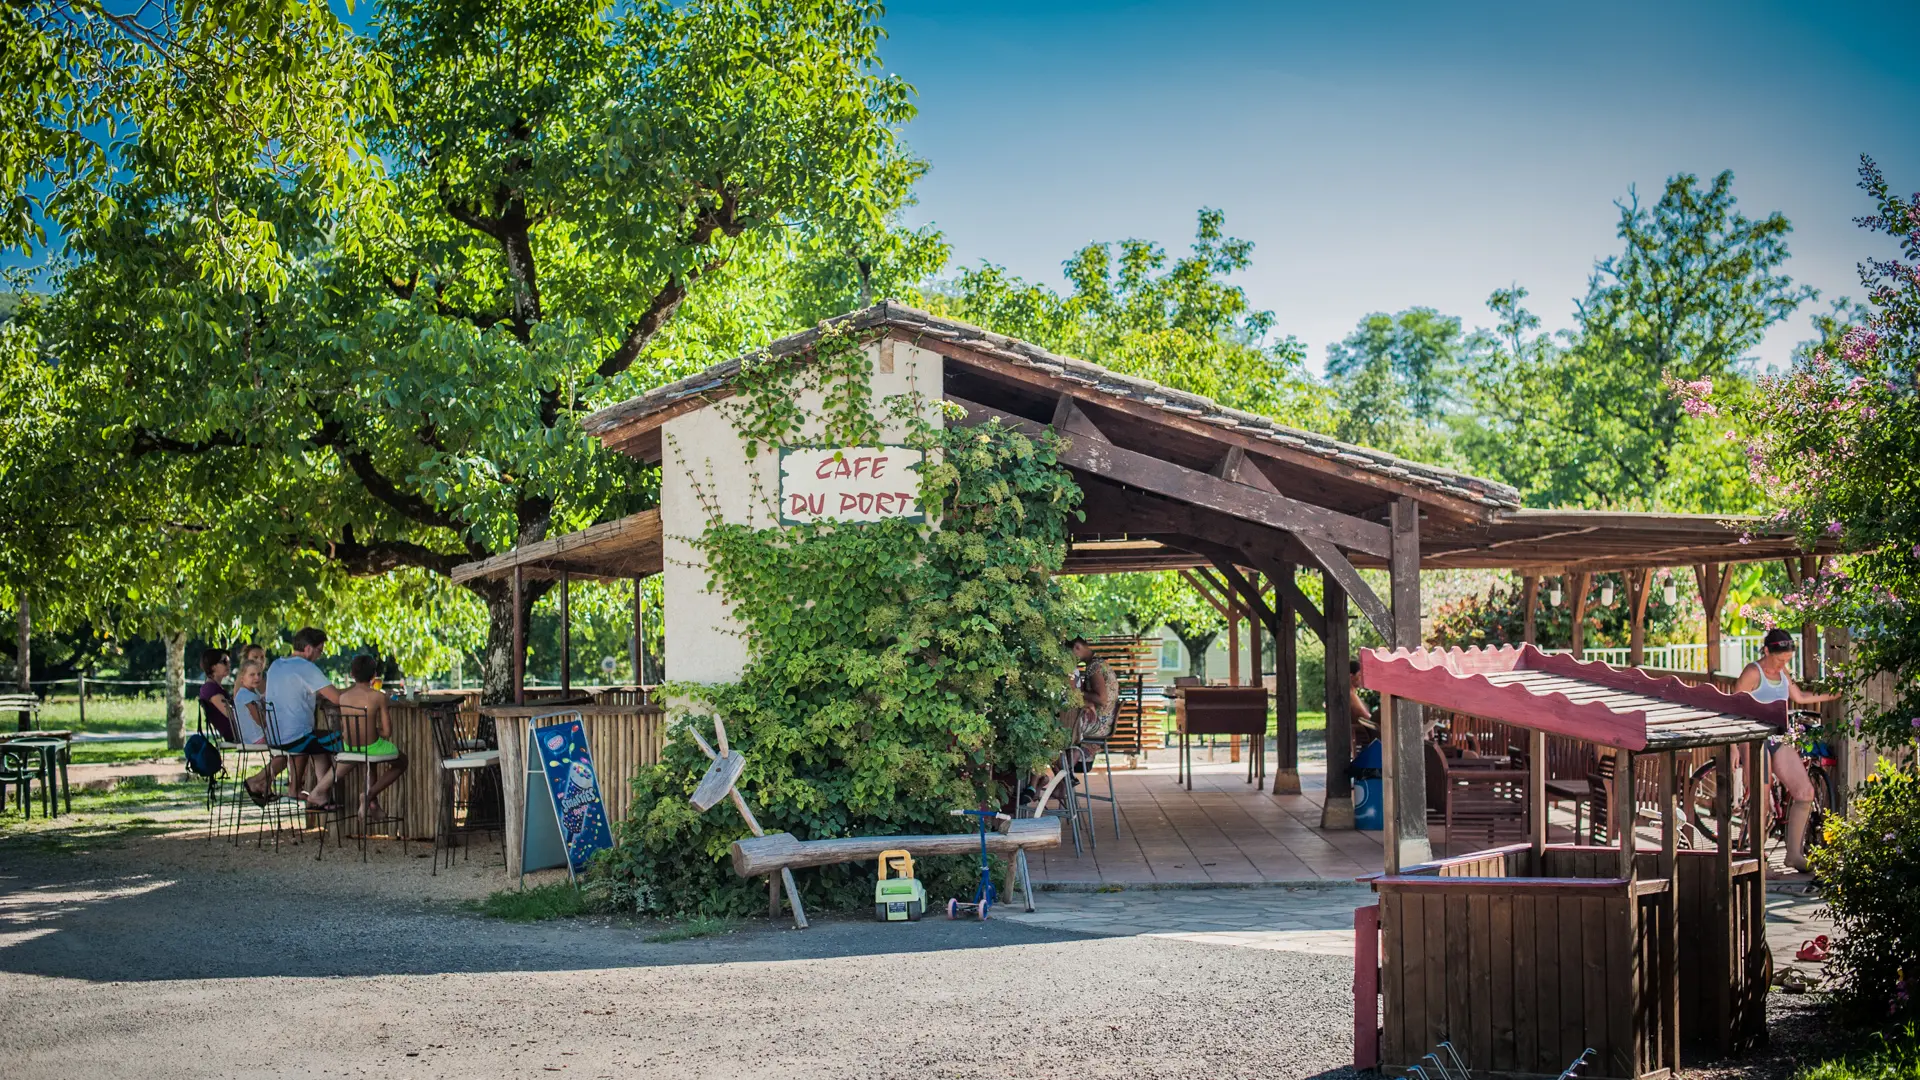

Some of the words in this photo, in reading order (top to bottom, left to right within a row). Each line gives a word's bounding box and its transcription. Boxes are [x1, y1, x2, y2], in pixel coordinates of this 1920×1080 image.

[816, 457, 888, 480] CAFE
[789, 493, 825, 515] DU
[839, 492, 914, 514] PORT
